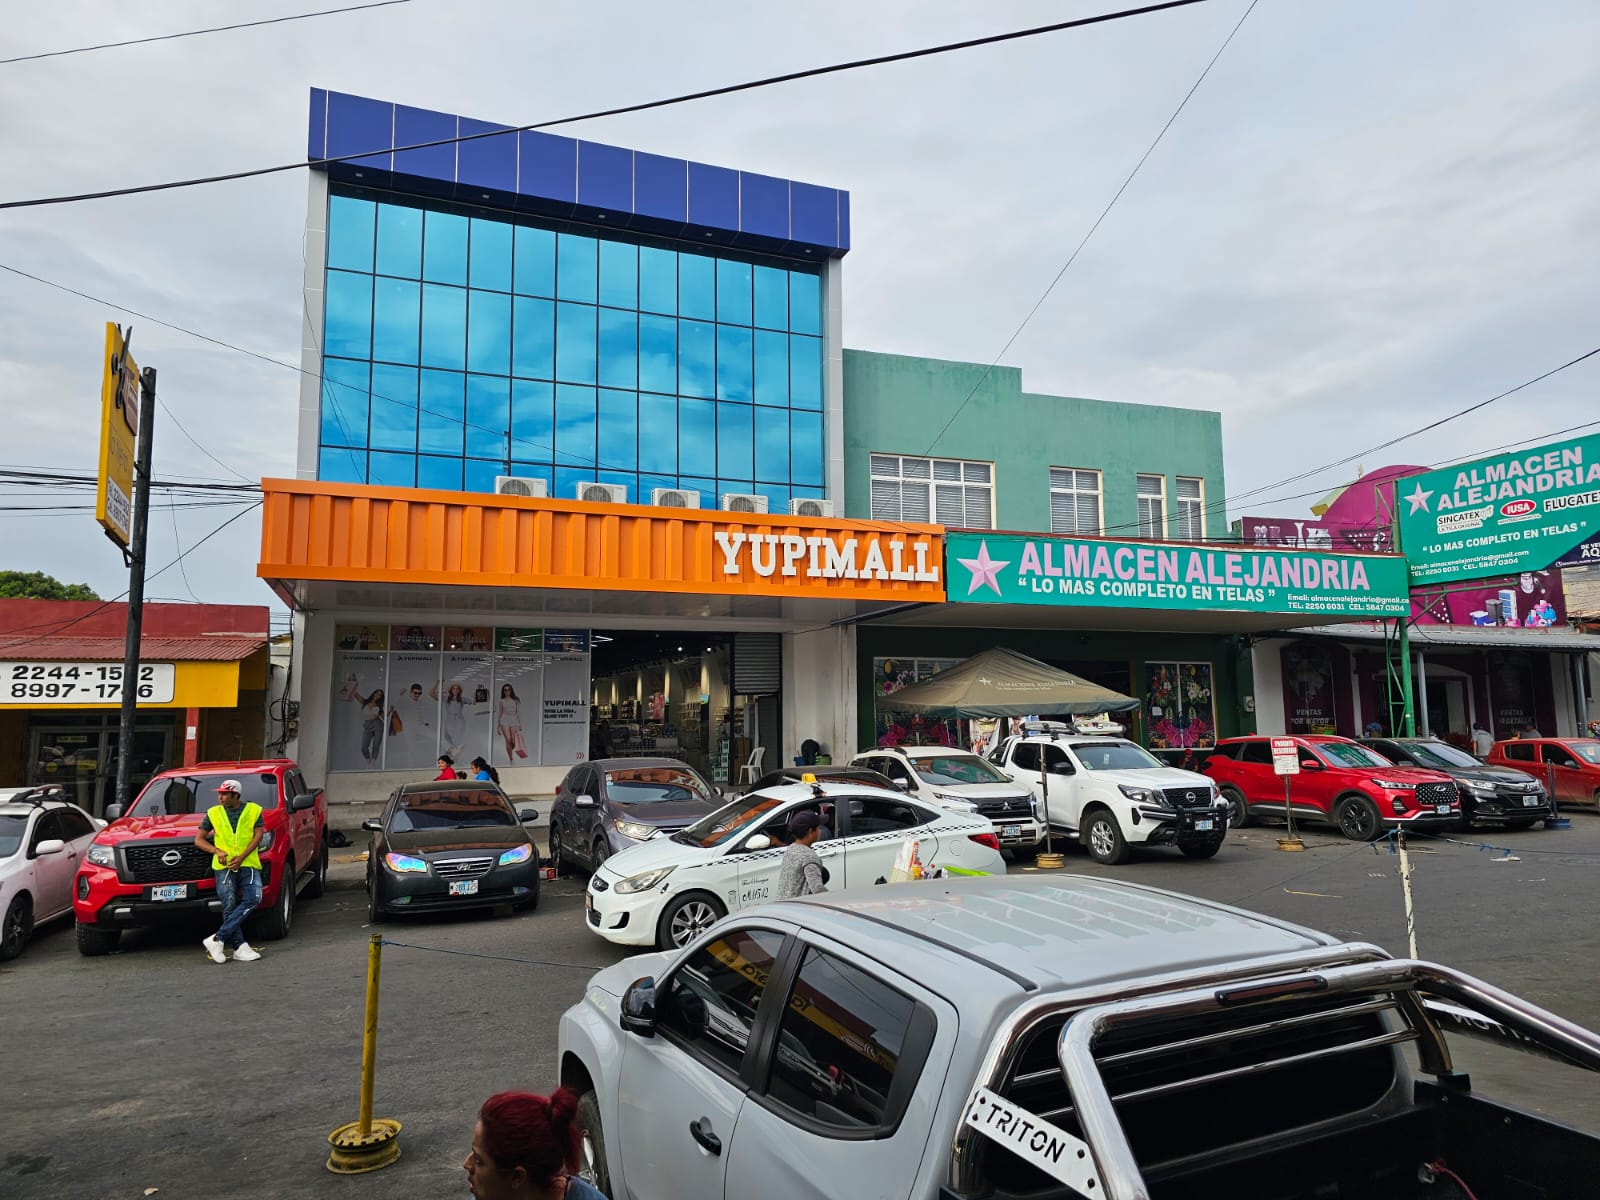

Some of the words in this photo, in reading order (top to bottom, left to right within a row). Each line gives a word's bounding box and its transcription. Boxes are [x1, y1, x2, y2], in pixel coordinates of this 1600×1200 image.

[1454, 446, 1582, 489] ALMACEN
[1437, 463, 1600, 511] ALEJANDRIA
[1507, 502, 1531, 514] IUSA
[1545, 491, 1600, 511] FLUCATE
[1438, 510, 1481, 525] SINCATEX
[1429, 543, 1442, 553] LO
[1444, 541, 1464, 552] MAS
[1466, 532, 1521, 548] COMPLETO
[1523, 529, 1540, 539] EN
[1541, 522, 1578, 536] TELAS
[714, 531, 939, 582] YUPIMALL
[1581, 547, 1600, 558] AQ
[1018, 542, 1179, 582] ALMACEN
[1185, 551, 1370, 590] ALEJANDRIA
[1031, 578, 1055, 593] LO
[1059, 579, 1096, 595] MAS
[1100, 581, 1188, 599] COMPLETO
[1192, 585, 1212, 600] EN
[1217, 586, 1265, 602] TELAS
[1311, 595, 1410, 605] almacenalejandria@gmail.co
[12, 665, 154, 681] 2244-152
[11, 683, 153, 698] 8997-176
[986, 1103, 1066, 1163] TRITON
